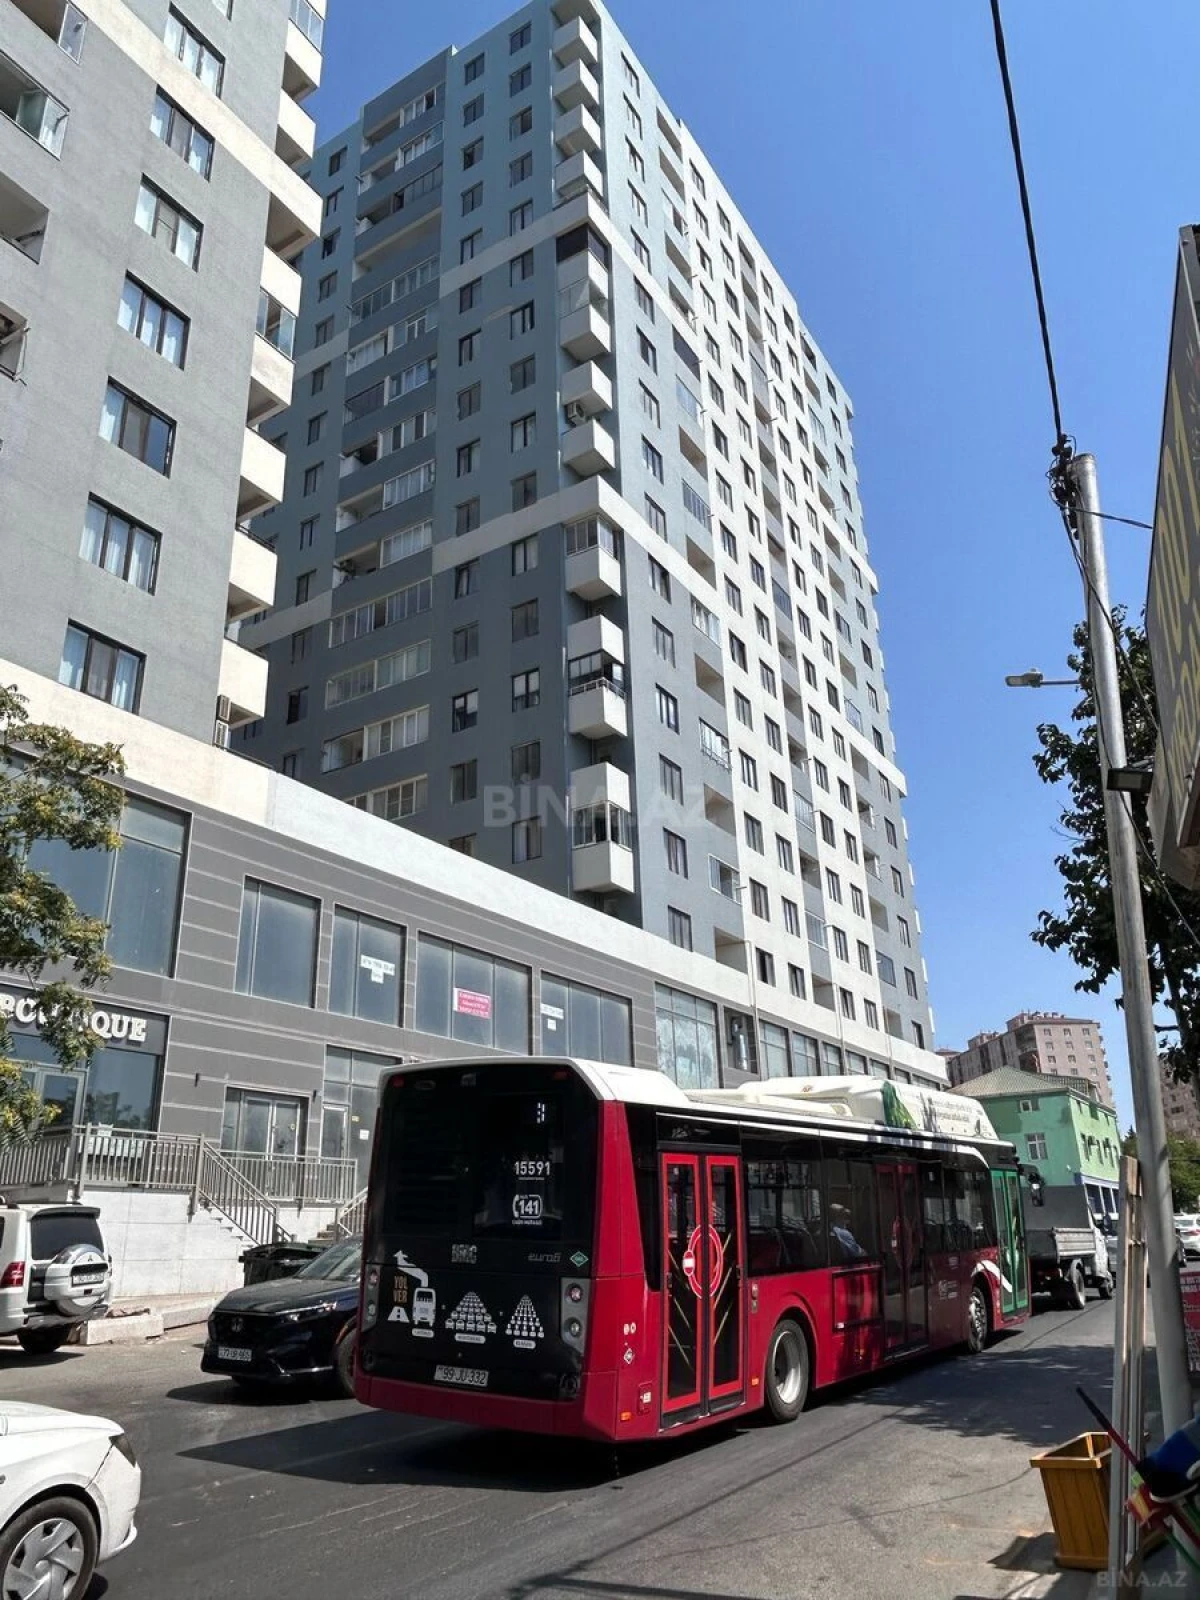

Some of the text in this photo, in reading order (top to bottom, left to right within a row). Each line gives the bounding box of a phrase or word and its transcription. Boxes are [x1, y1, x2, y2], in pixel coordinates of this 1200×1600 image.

[514, 1161, 550, 1175] 15591
[518, 1199, 539, 1215] 141
[394, 1275, 408, 1289] YOL
[393, 1289, 407, 1303] VER
